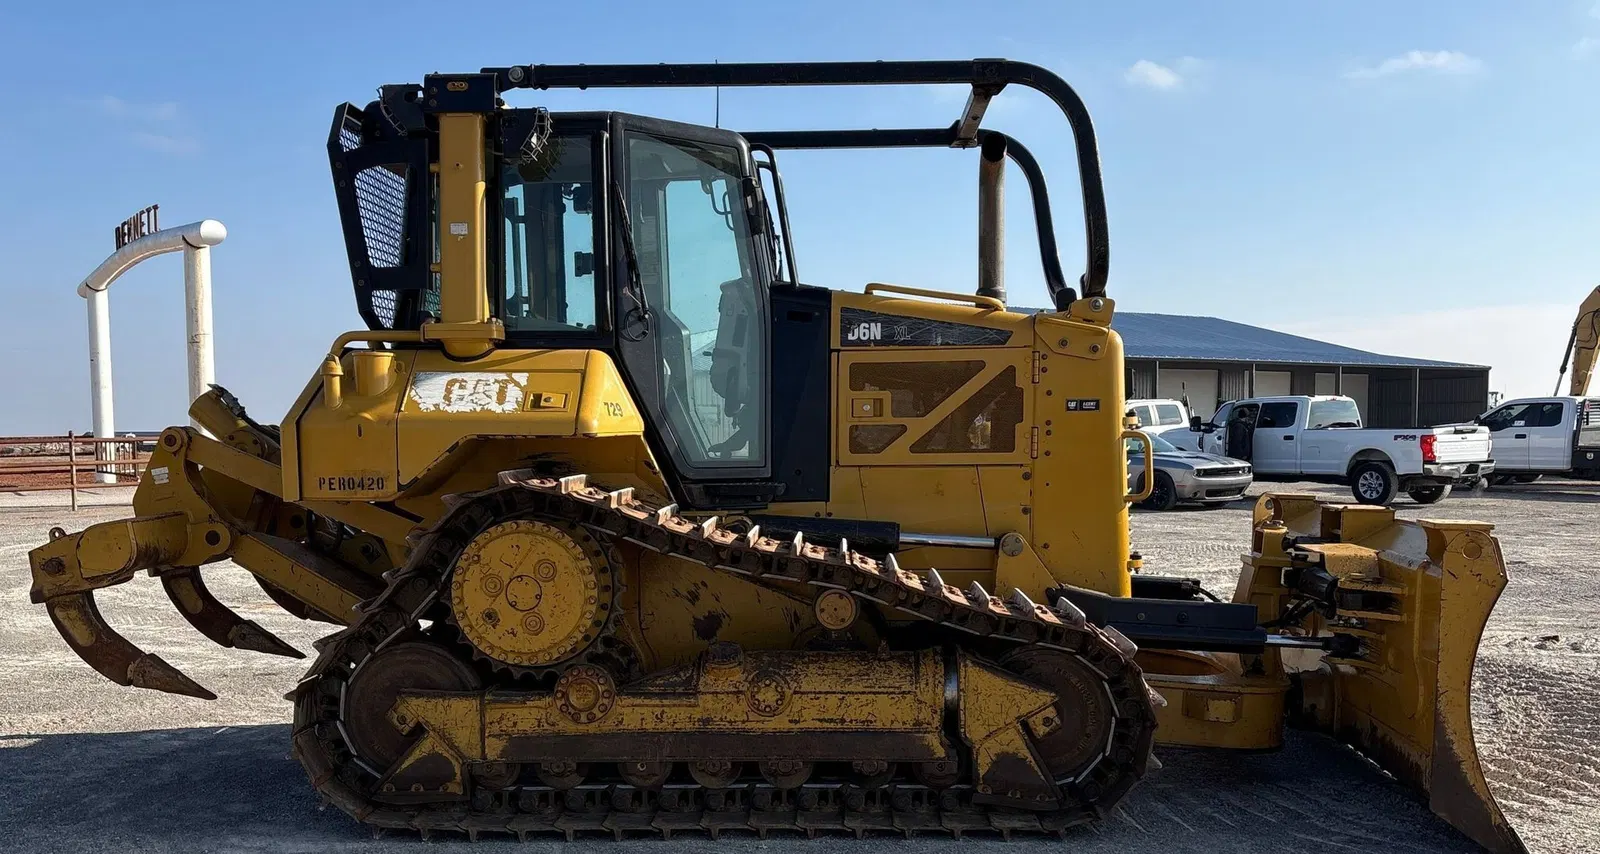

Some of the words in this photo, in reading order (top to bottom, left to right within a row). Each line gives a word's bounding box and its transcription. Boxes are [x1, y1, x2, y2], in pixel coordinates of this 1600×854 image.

[848, 322, 881, 340] D6N
[894, 326, 911, 340] XL
[603, 402, 623, 417] 729
